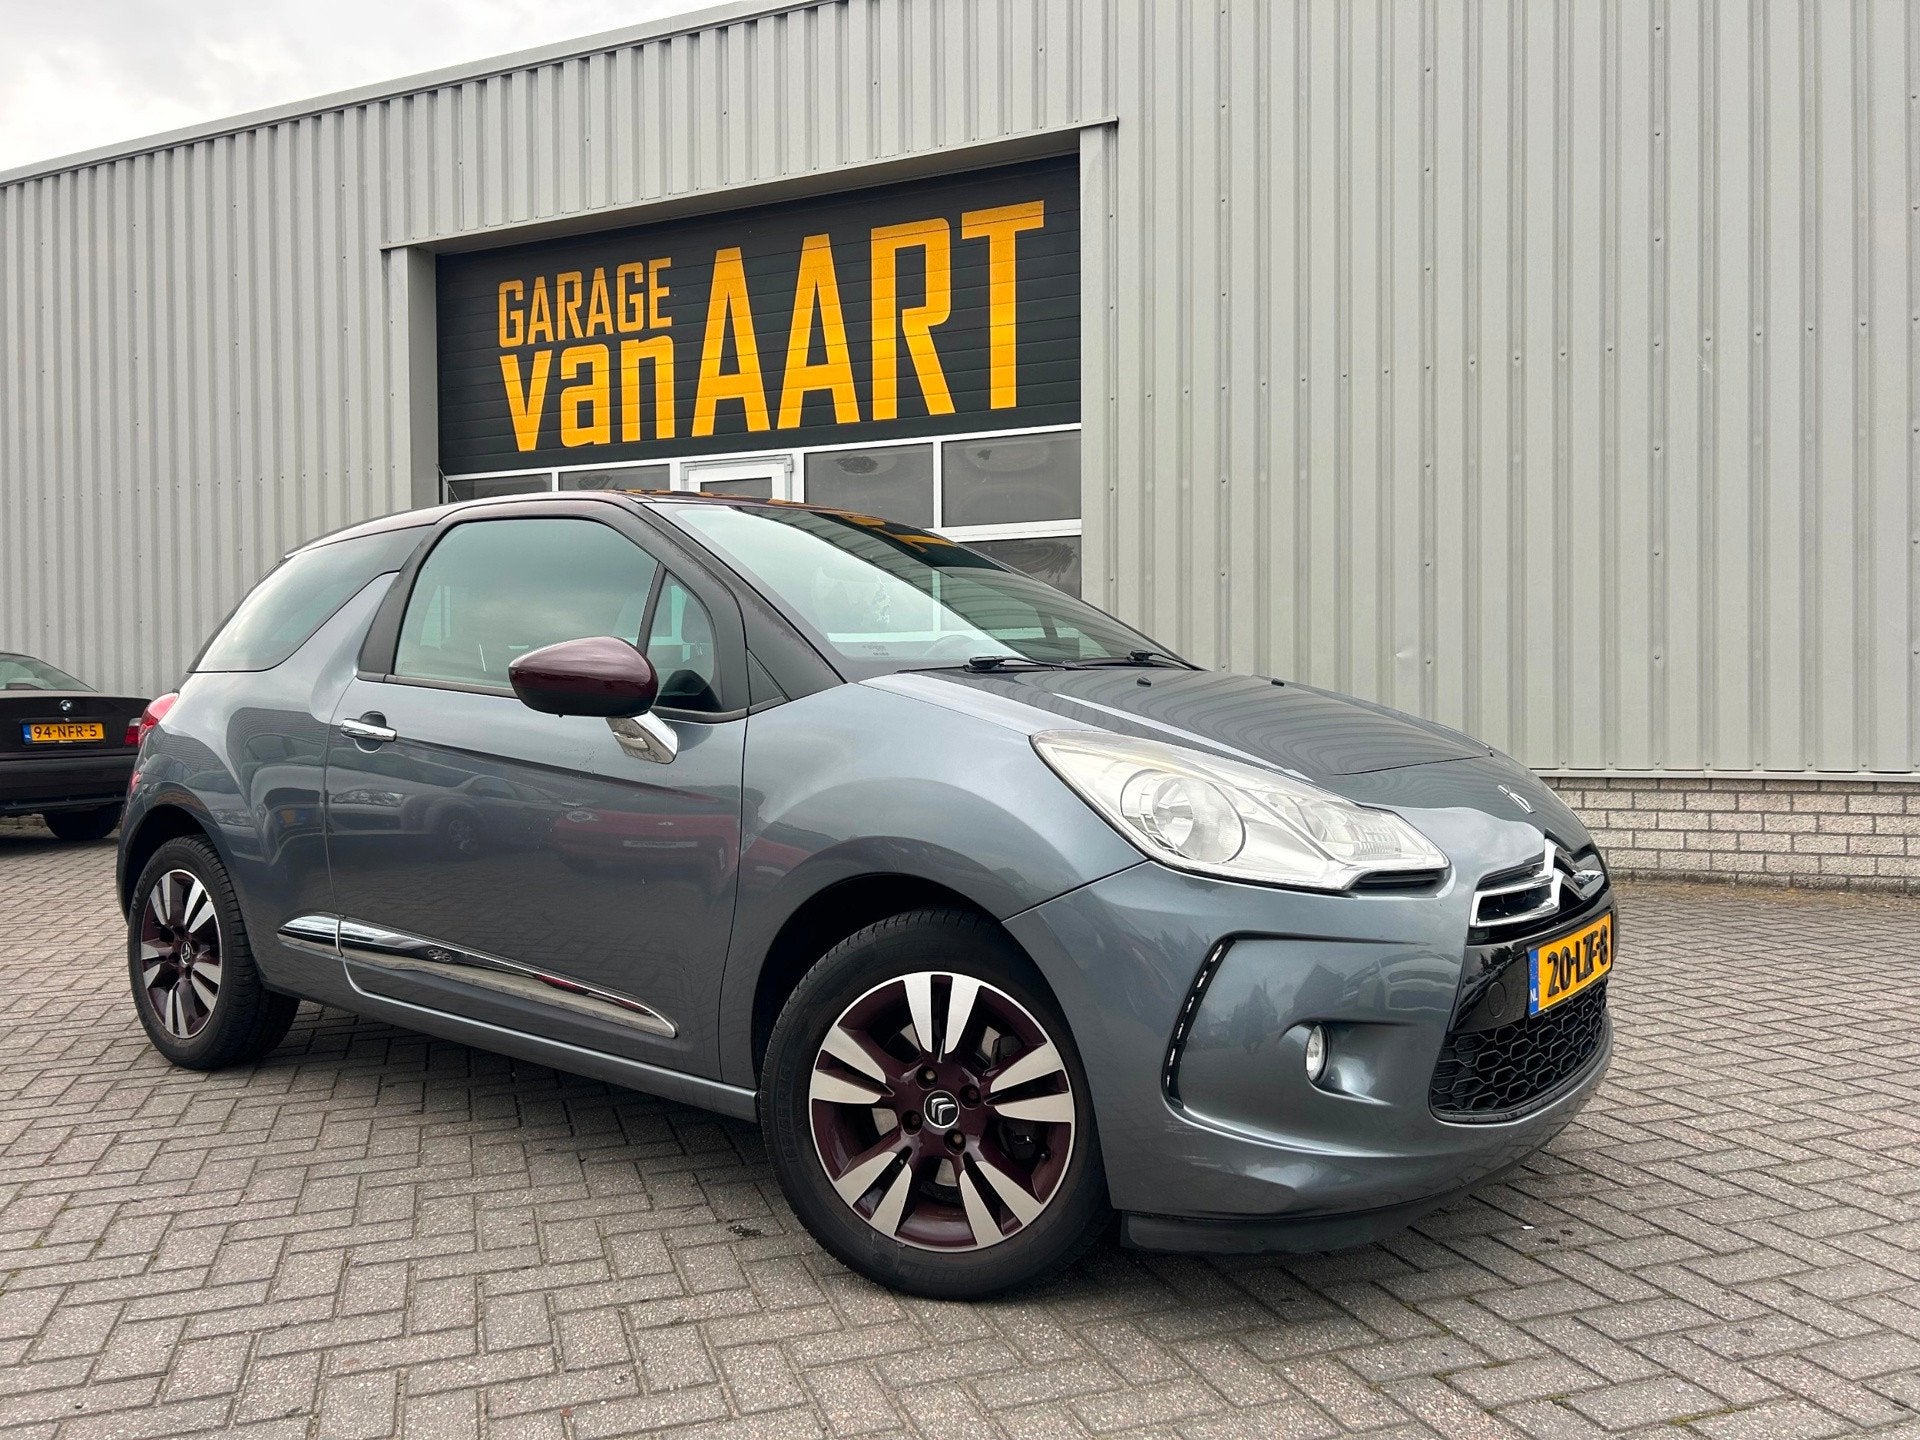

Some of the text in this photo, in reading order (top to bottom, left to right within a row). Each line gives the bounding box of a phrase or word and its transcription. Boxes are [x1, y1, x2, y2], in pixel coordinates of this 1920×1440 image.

[499, 257, 673, 348] GARAGE
[500, 201, 1045, 453] van AART
[33, 725, 97, 738] 94-NFR-5
[1530, 988, 1538, 1003] NL
